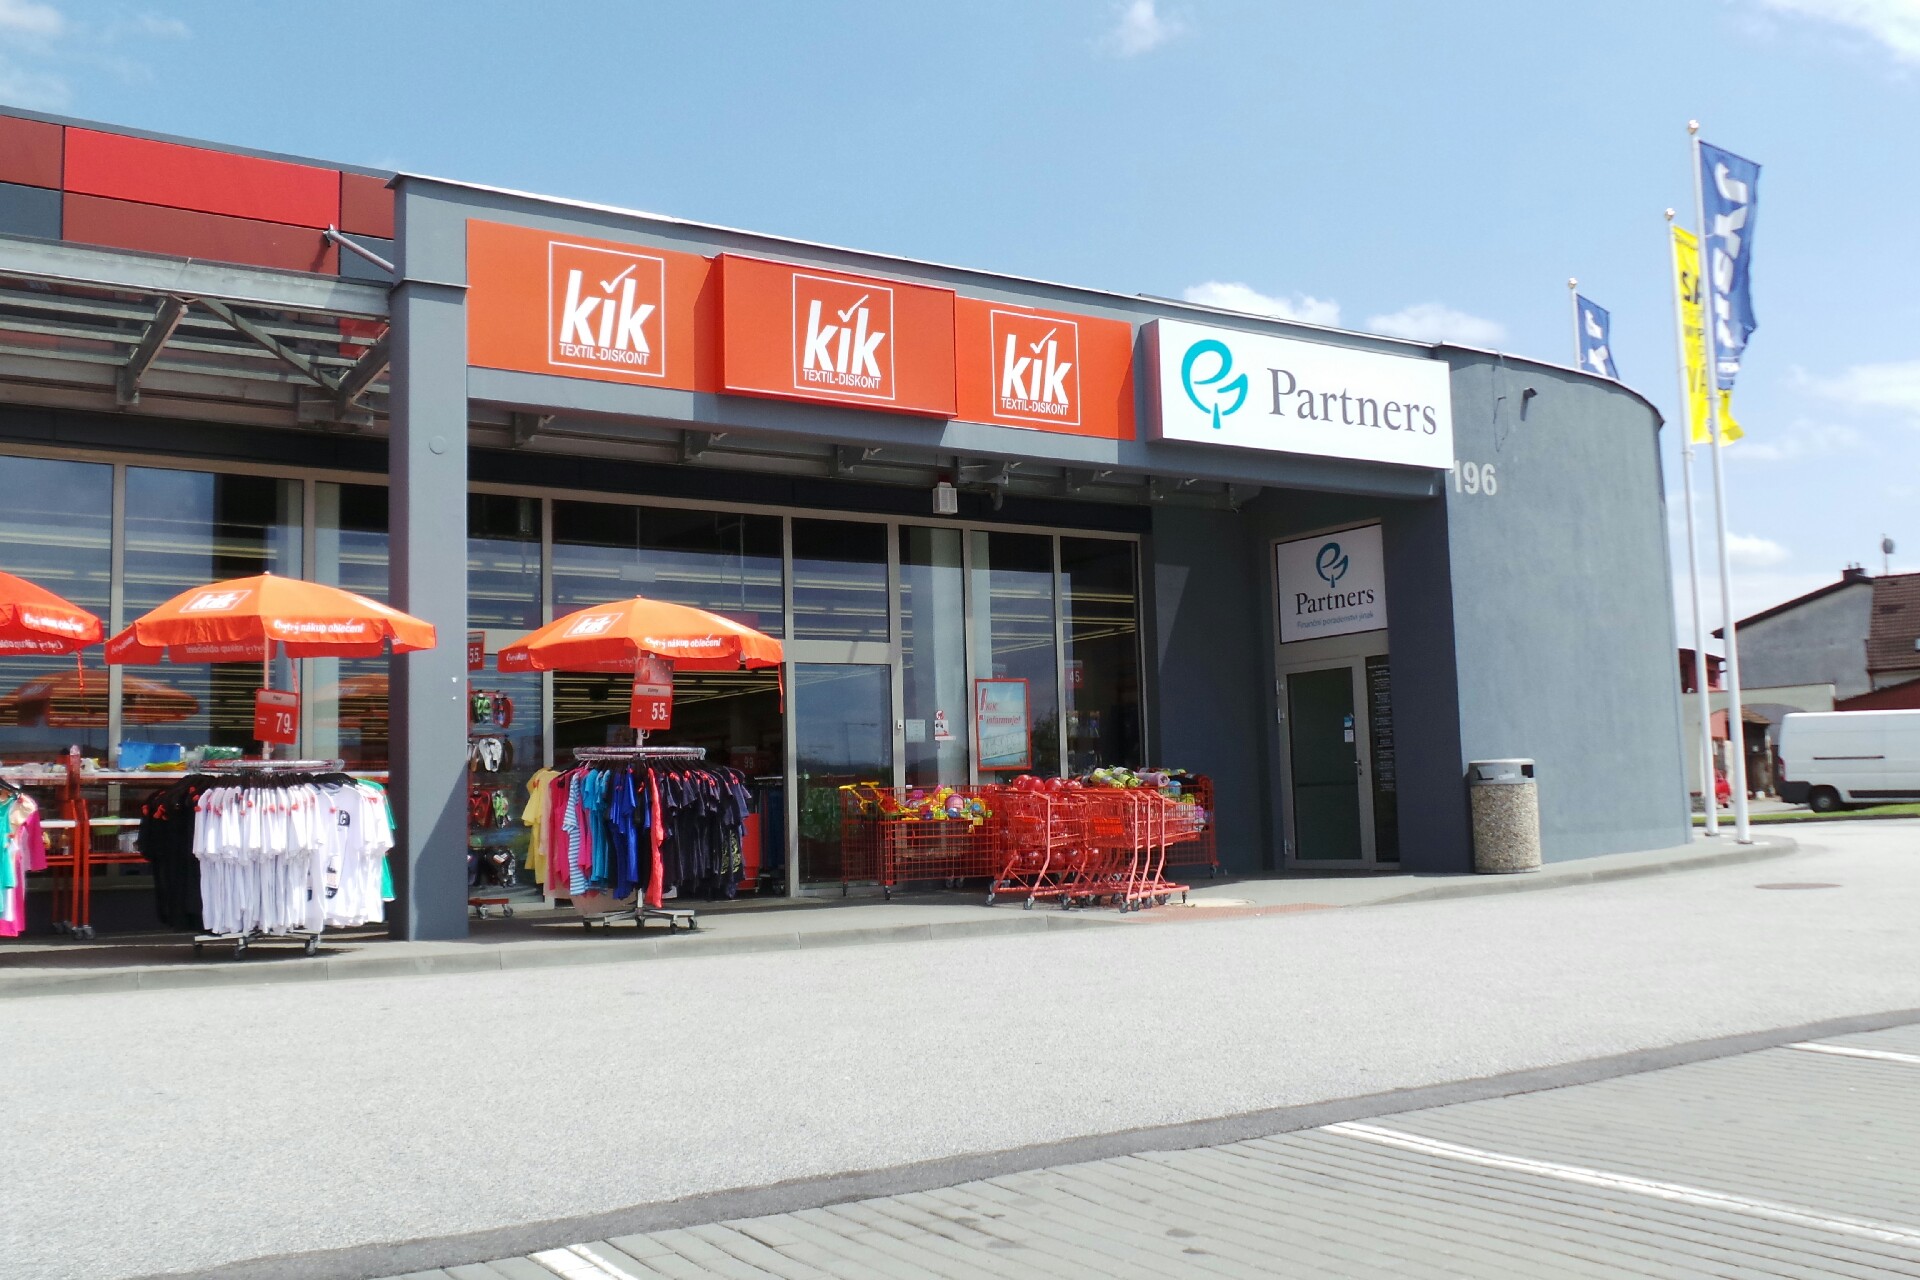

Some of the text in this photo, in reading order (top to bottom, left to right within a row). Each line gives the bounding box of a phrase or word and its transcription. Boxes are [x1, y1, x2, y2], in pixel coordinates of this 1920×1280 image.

[558, 342, 649, 366] TEXTIL-DISKONT
[802, 368, 881, 389] TEXTIL-DISKONT
[1001, 397, 1068, 416] TEXTIL-DISKONT
[1266, 367, 1437, 436] Partners
[1449, 460, 1498, 496] 196
[1295, 588, 1375, 616] Partners
